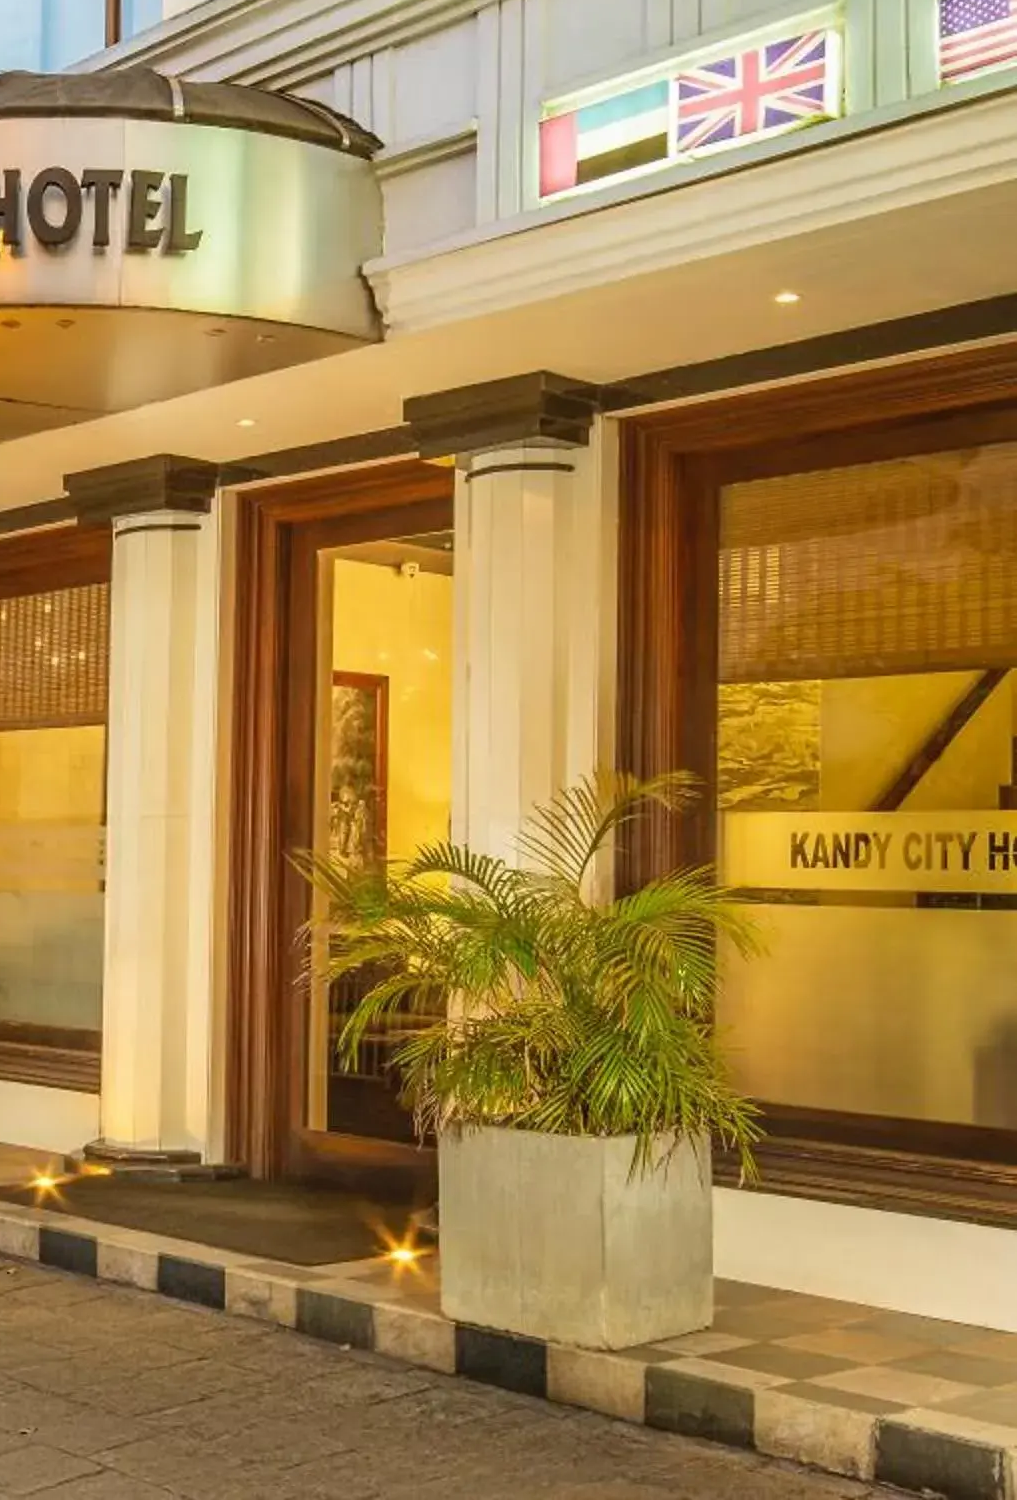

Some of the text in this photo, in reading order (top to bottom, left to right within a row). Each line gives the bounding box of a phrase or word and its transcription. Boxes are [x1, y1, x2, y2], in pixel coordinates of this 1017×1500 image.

[790, 832, 1017, 871] KANDY CITY H
